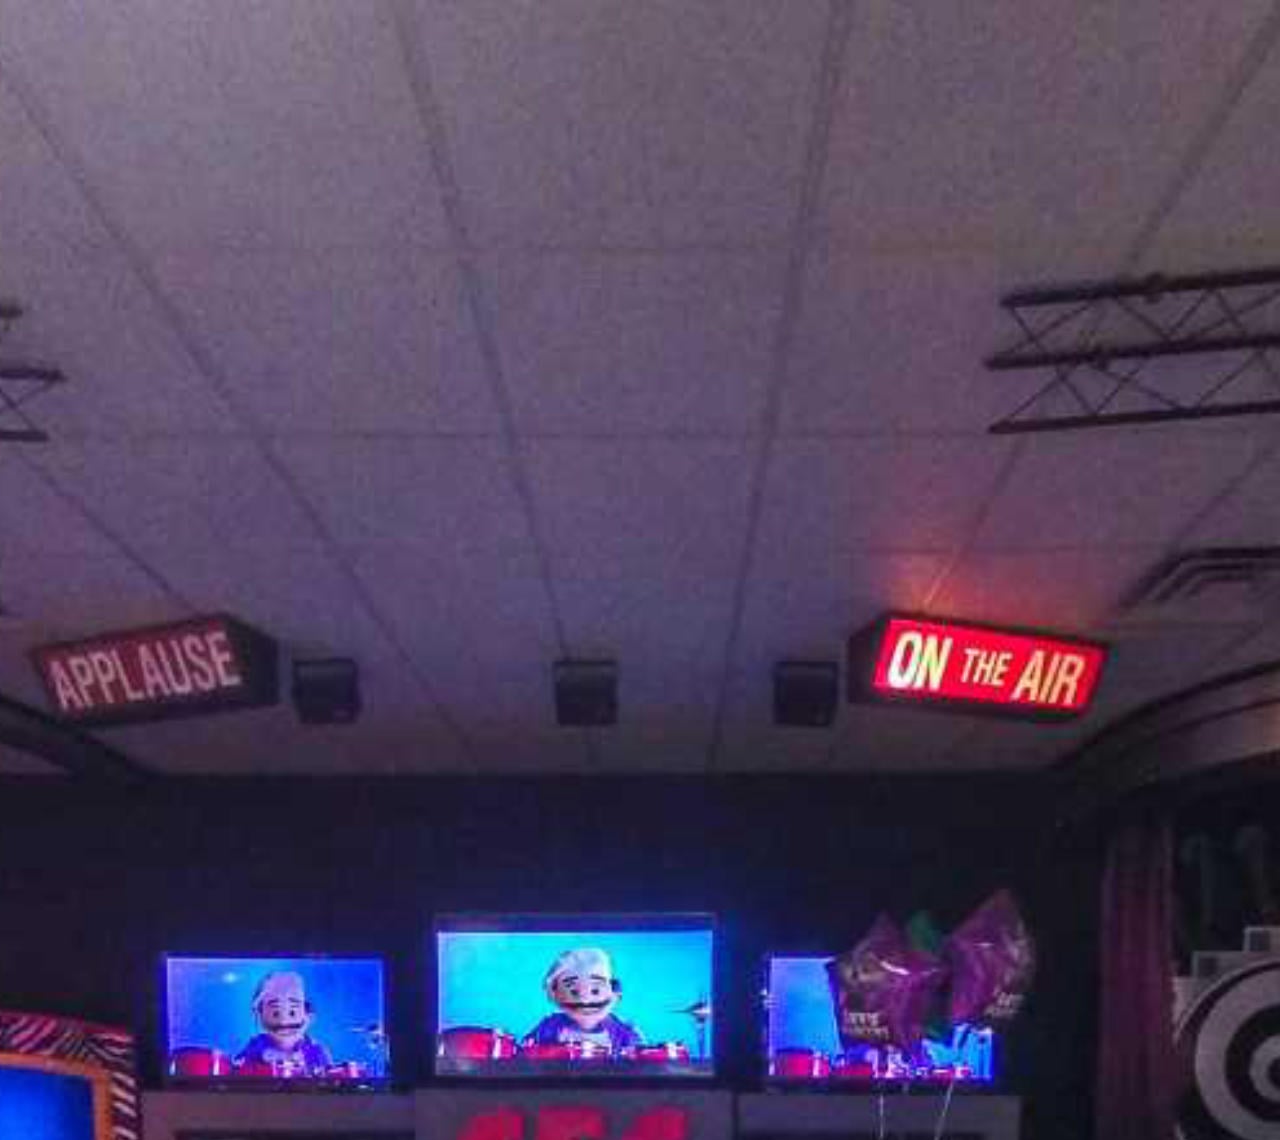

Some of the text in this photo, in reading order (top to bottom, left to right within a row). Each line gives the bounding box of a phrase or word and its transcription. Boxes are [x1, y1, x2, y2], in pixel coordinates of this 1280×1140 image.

[48, 630, 242, 711] APPLAUSE
[886, 631, 1091, 705] ON THE AIR
